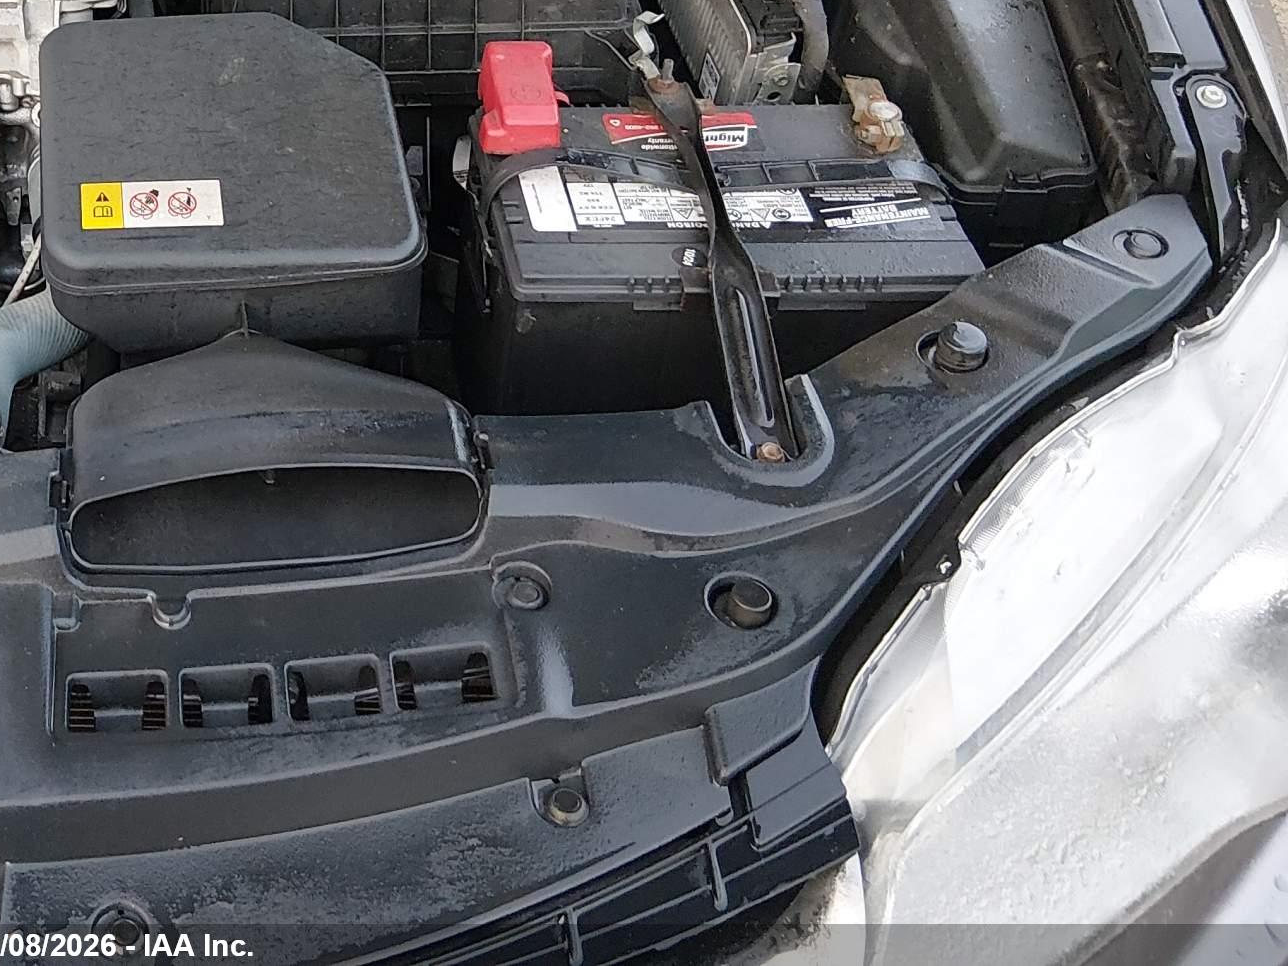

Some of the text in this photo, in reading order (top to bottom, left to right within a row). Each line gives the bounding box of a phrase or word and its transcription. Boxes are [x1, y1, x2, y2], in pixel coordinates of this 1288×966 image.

[705, 132, 745, 143] Might
[852, 204, 898, 217] BATTERY
[824, 206, 930, 228] MAINTENANCE-FREE
[731, 221, 761, 229] DAN
